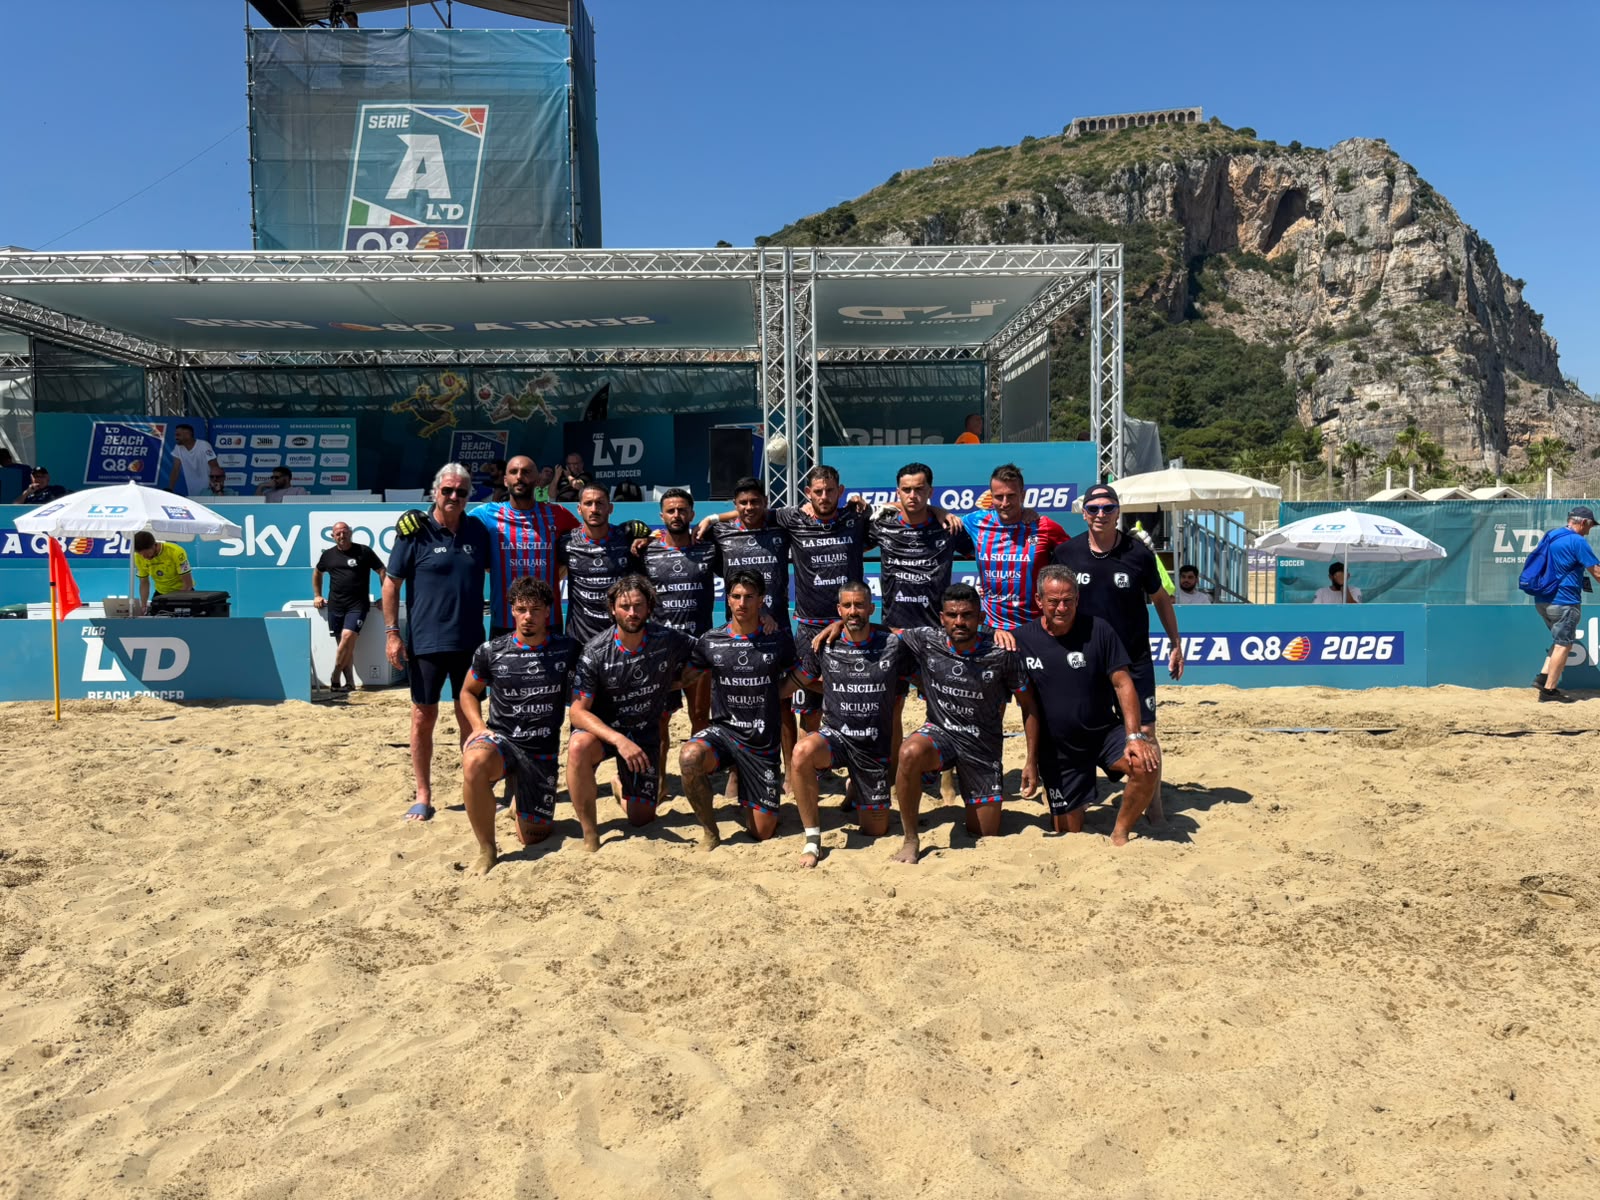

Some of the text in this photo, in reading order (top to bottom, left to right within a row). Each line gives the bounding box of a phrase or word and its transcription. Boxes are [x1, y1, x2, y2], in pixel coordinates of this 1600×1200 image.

[368, 115, 411, 129] SERIE
[385, 134, 452, 199] A
[356, 231, 410, 250] Q8
[104, 435, 144, 446] BEACH
[219, 437, 233, 446] Q8
[461, 441, 492, 450] BEACH
[101, 446, 148, 456] SOCCER
[458, 450, 495, 460] SOCCER
[102, 458, 127, 472] Q8
[595, 469, 642, 479] BEACH SOCCER
[940, 489, 974, 511] Q8
[1023, 487, 1070, 508] 026
[1, 533, 23, 554] A
[500, 541, 553, 550] LA SICILIA
[802, 536, 853, 548] LA SICILIA
[728, 555, 778, 566] LA SICILIA
[978, 552, 1031, 562] LA SICILIA
[1495, 556, 1517, 564] BEACH
[1279, 560, 1305, 568] SOCCER
[667, 582, 703, 592] SICILIA
[81, 626, 106, 636] FIGC
[1149, 635, 1396, 662] ERIE A Q8 2026
[1025, 657, 1044, 670] RA
[719, 675, 771, 687] LA SICILIA
[503, 684, 561, 697] LA SICILIA
[832, 682, 887, 693] LA SICILIA
[942, 685, 984, 700] SICILIA
[87, 691, 131, 700] BEACH
[1049, 787, 1065, 800] RA
